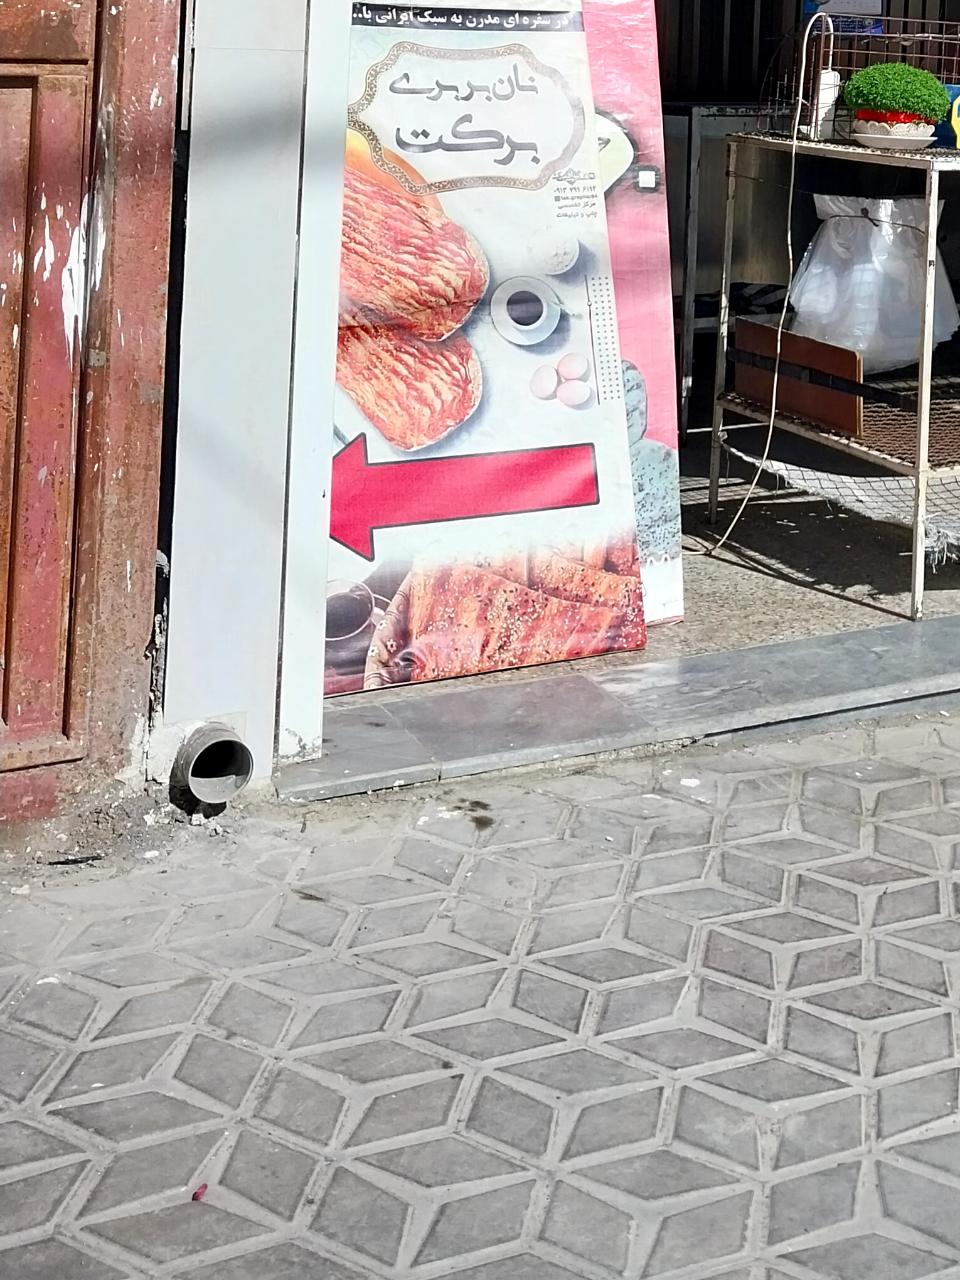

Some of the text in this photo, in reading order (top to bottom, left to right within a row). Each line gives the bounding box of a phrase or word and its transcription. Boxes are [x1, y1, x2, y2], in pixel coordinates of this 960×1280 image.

[375, 7, 414, 25] ایرانی
[416, 9, 447, 26] سبک
[450, 12, 463, 27] به
[466, 13, 501, 28] مدرن
[503, 12, 520, 29] ای
[522, 13, 551, 29] سفره
[554, 15, 570, 29] در
[389, 63, 538, 101] نان بربری
[395, 113, 541, 165] برکت
